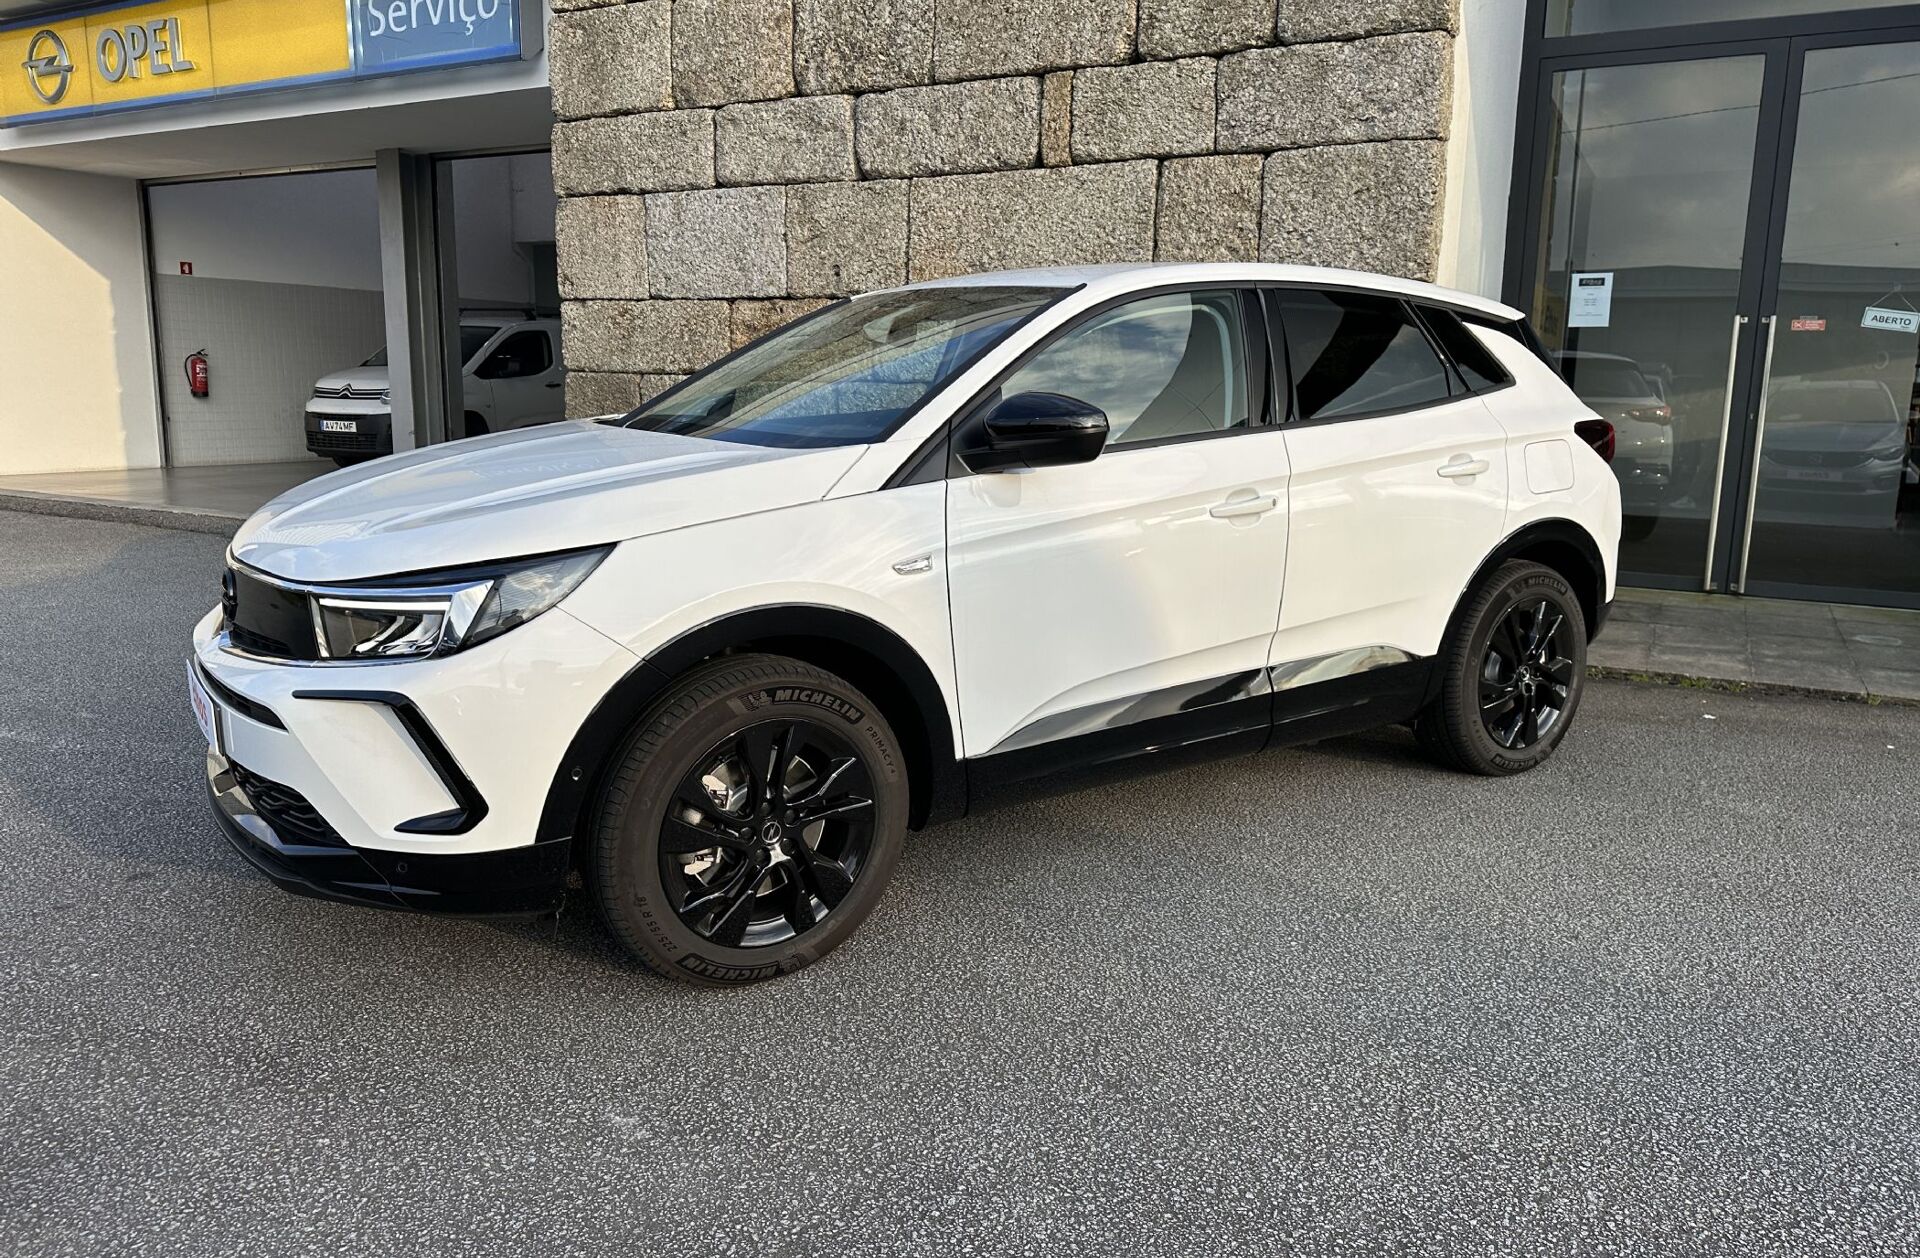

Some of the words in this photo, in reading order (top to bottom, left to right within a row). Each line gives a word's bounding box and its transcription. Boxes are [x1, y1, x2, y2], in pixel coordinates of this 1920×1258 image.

[368, 0, 499, 36] Serviço
[96, 17, 195, 83] OPEL
[1871, 314, 1911, 326] ABERTO
[1528, 576, 1567, 593] MICHELIN
[774, 689, 862, 721] MICHELIN
[865, 726, 894, 768] PRIMACY
[646, 920, 678, 952] 225/55
[681, 956, 778, 981] MICHELIN
